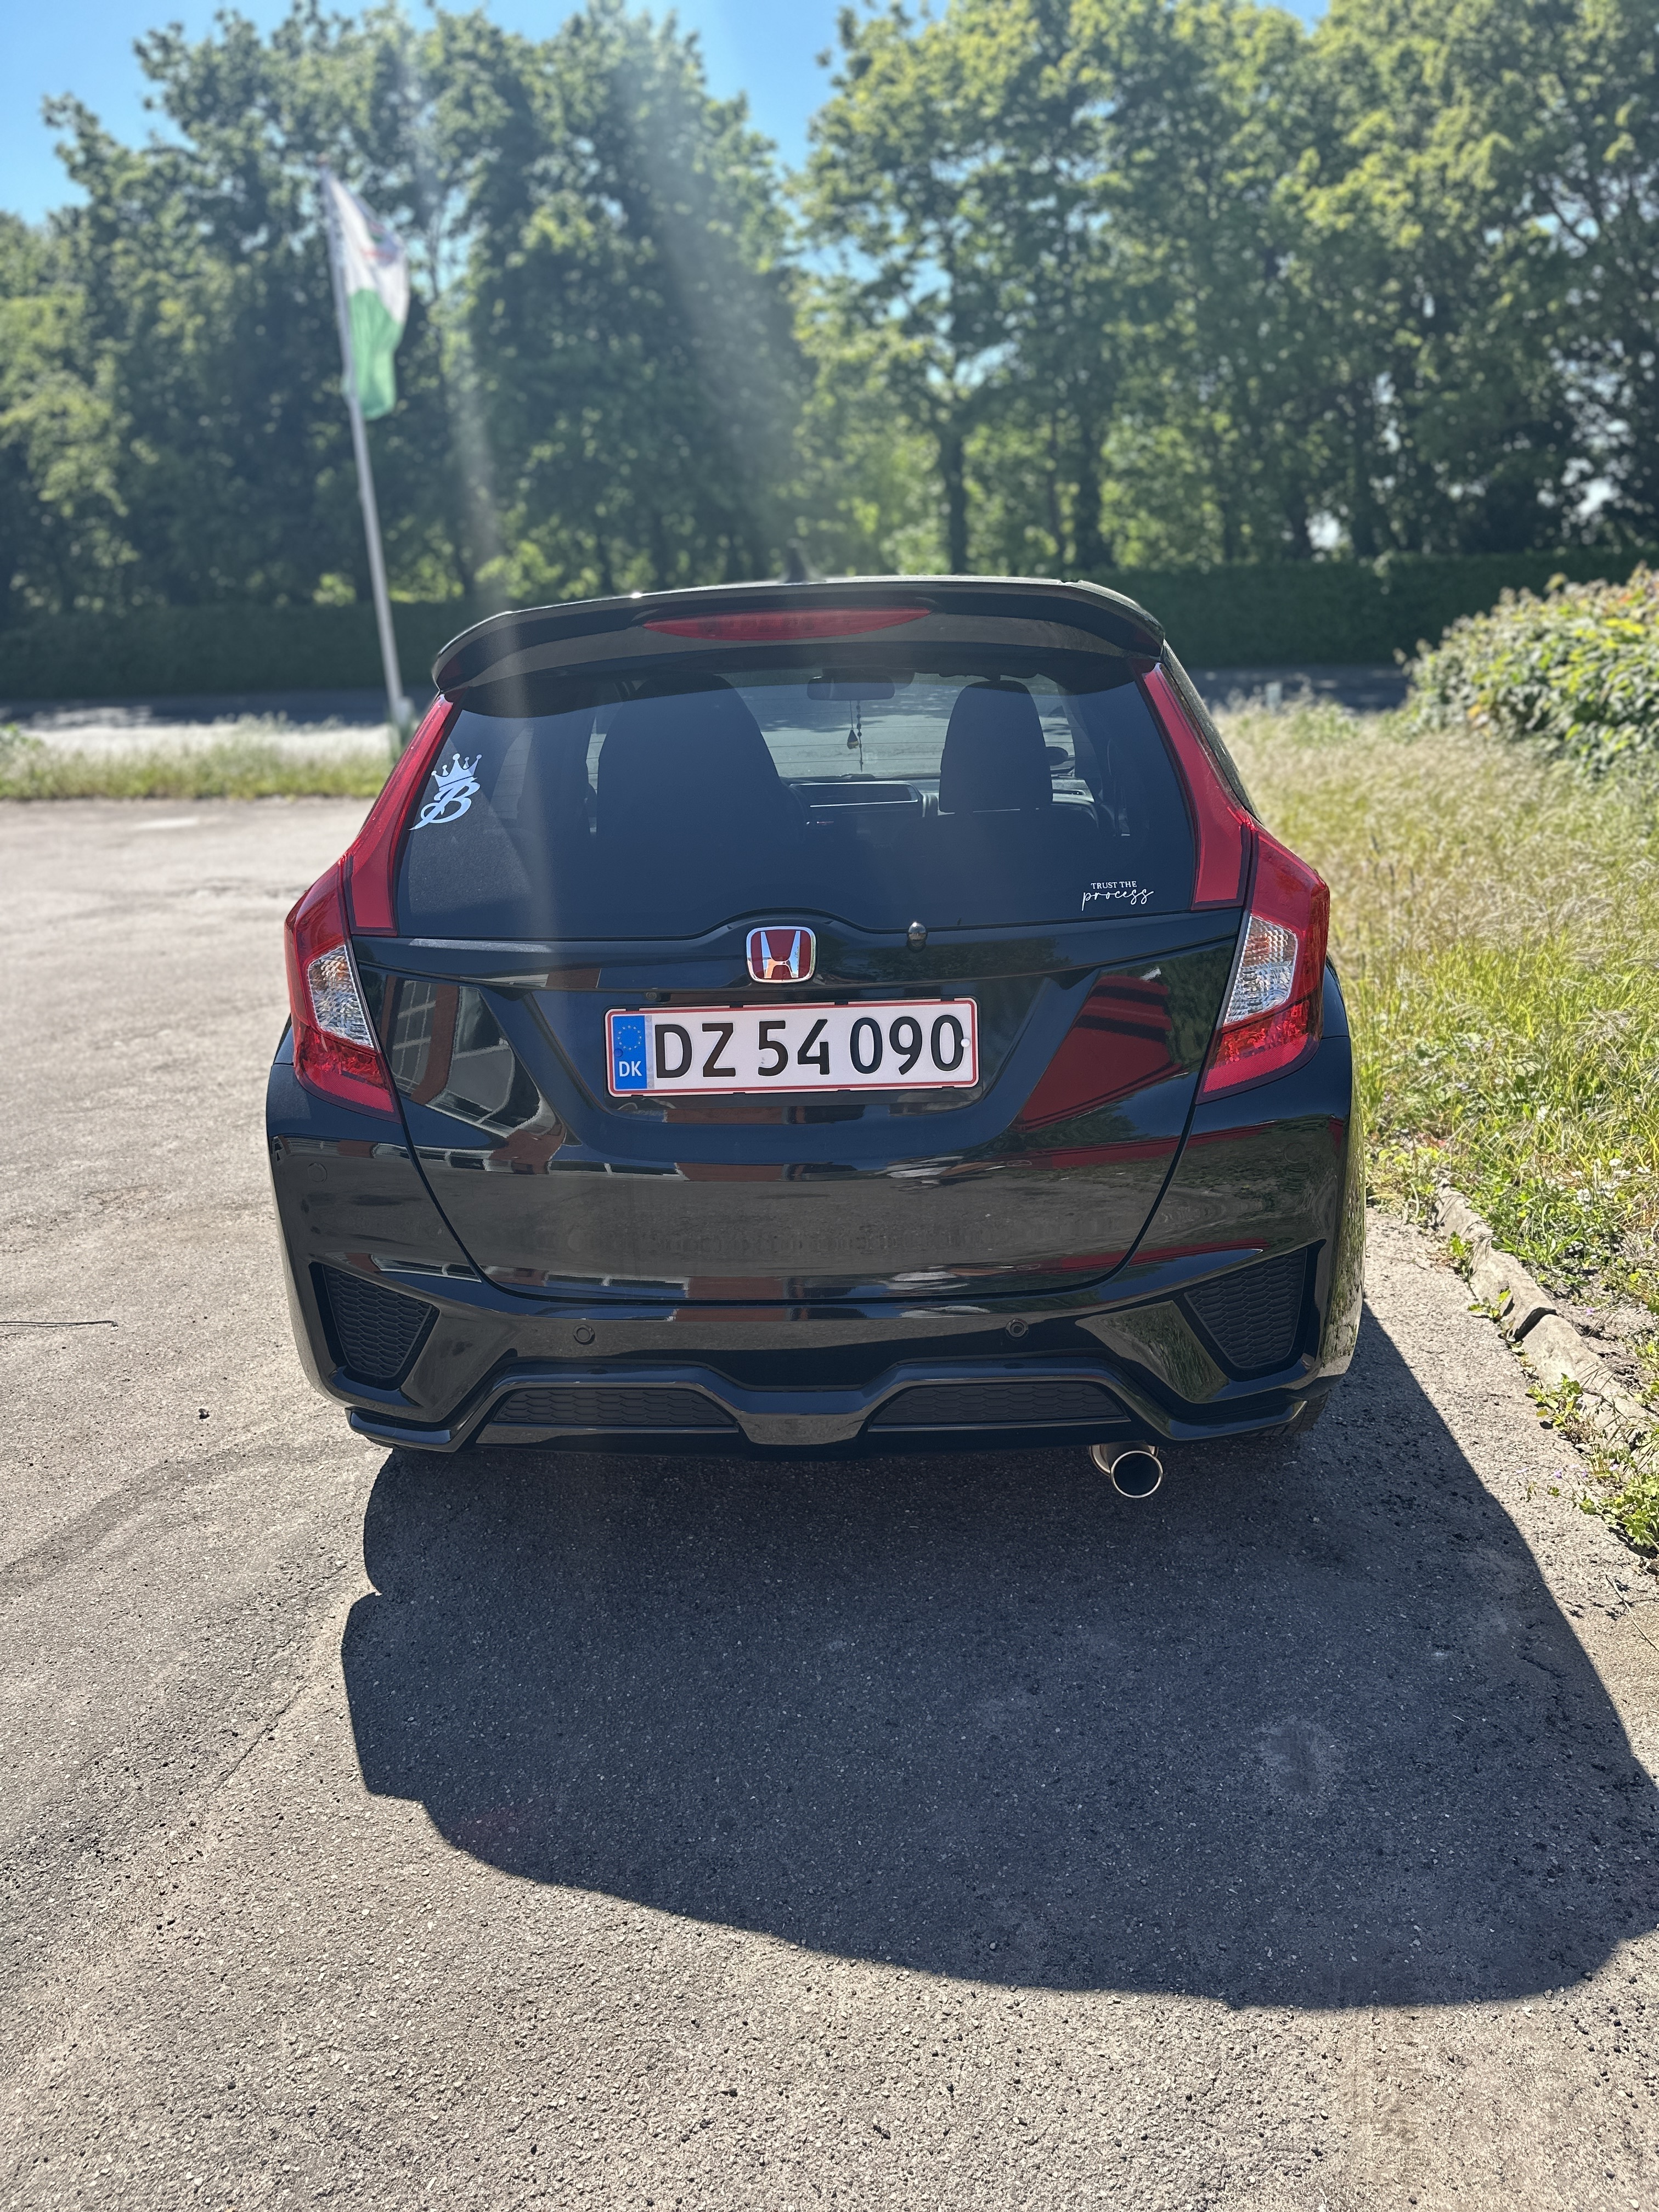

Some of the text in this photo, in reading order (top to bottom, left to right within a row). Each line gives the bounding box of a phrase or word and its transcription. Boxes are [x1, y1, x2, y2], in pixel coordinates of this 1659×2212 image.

[1091, 881, 1118, 889] TRUST
[1081, 889, 1154, 911] process
[654, 1014, 964, 1079] DZ 54 090
[618, 1060, 643, 1078] DK
